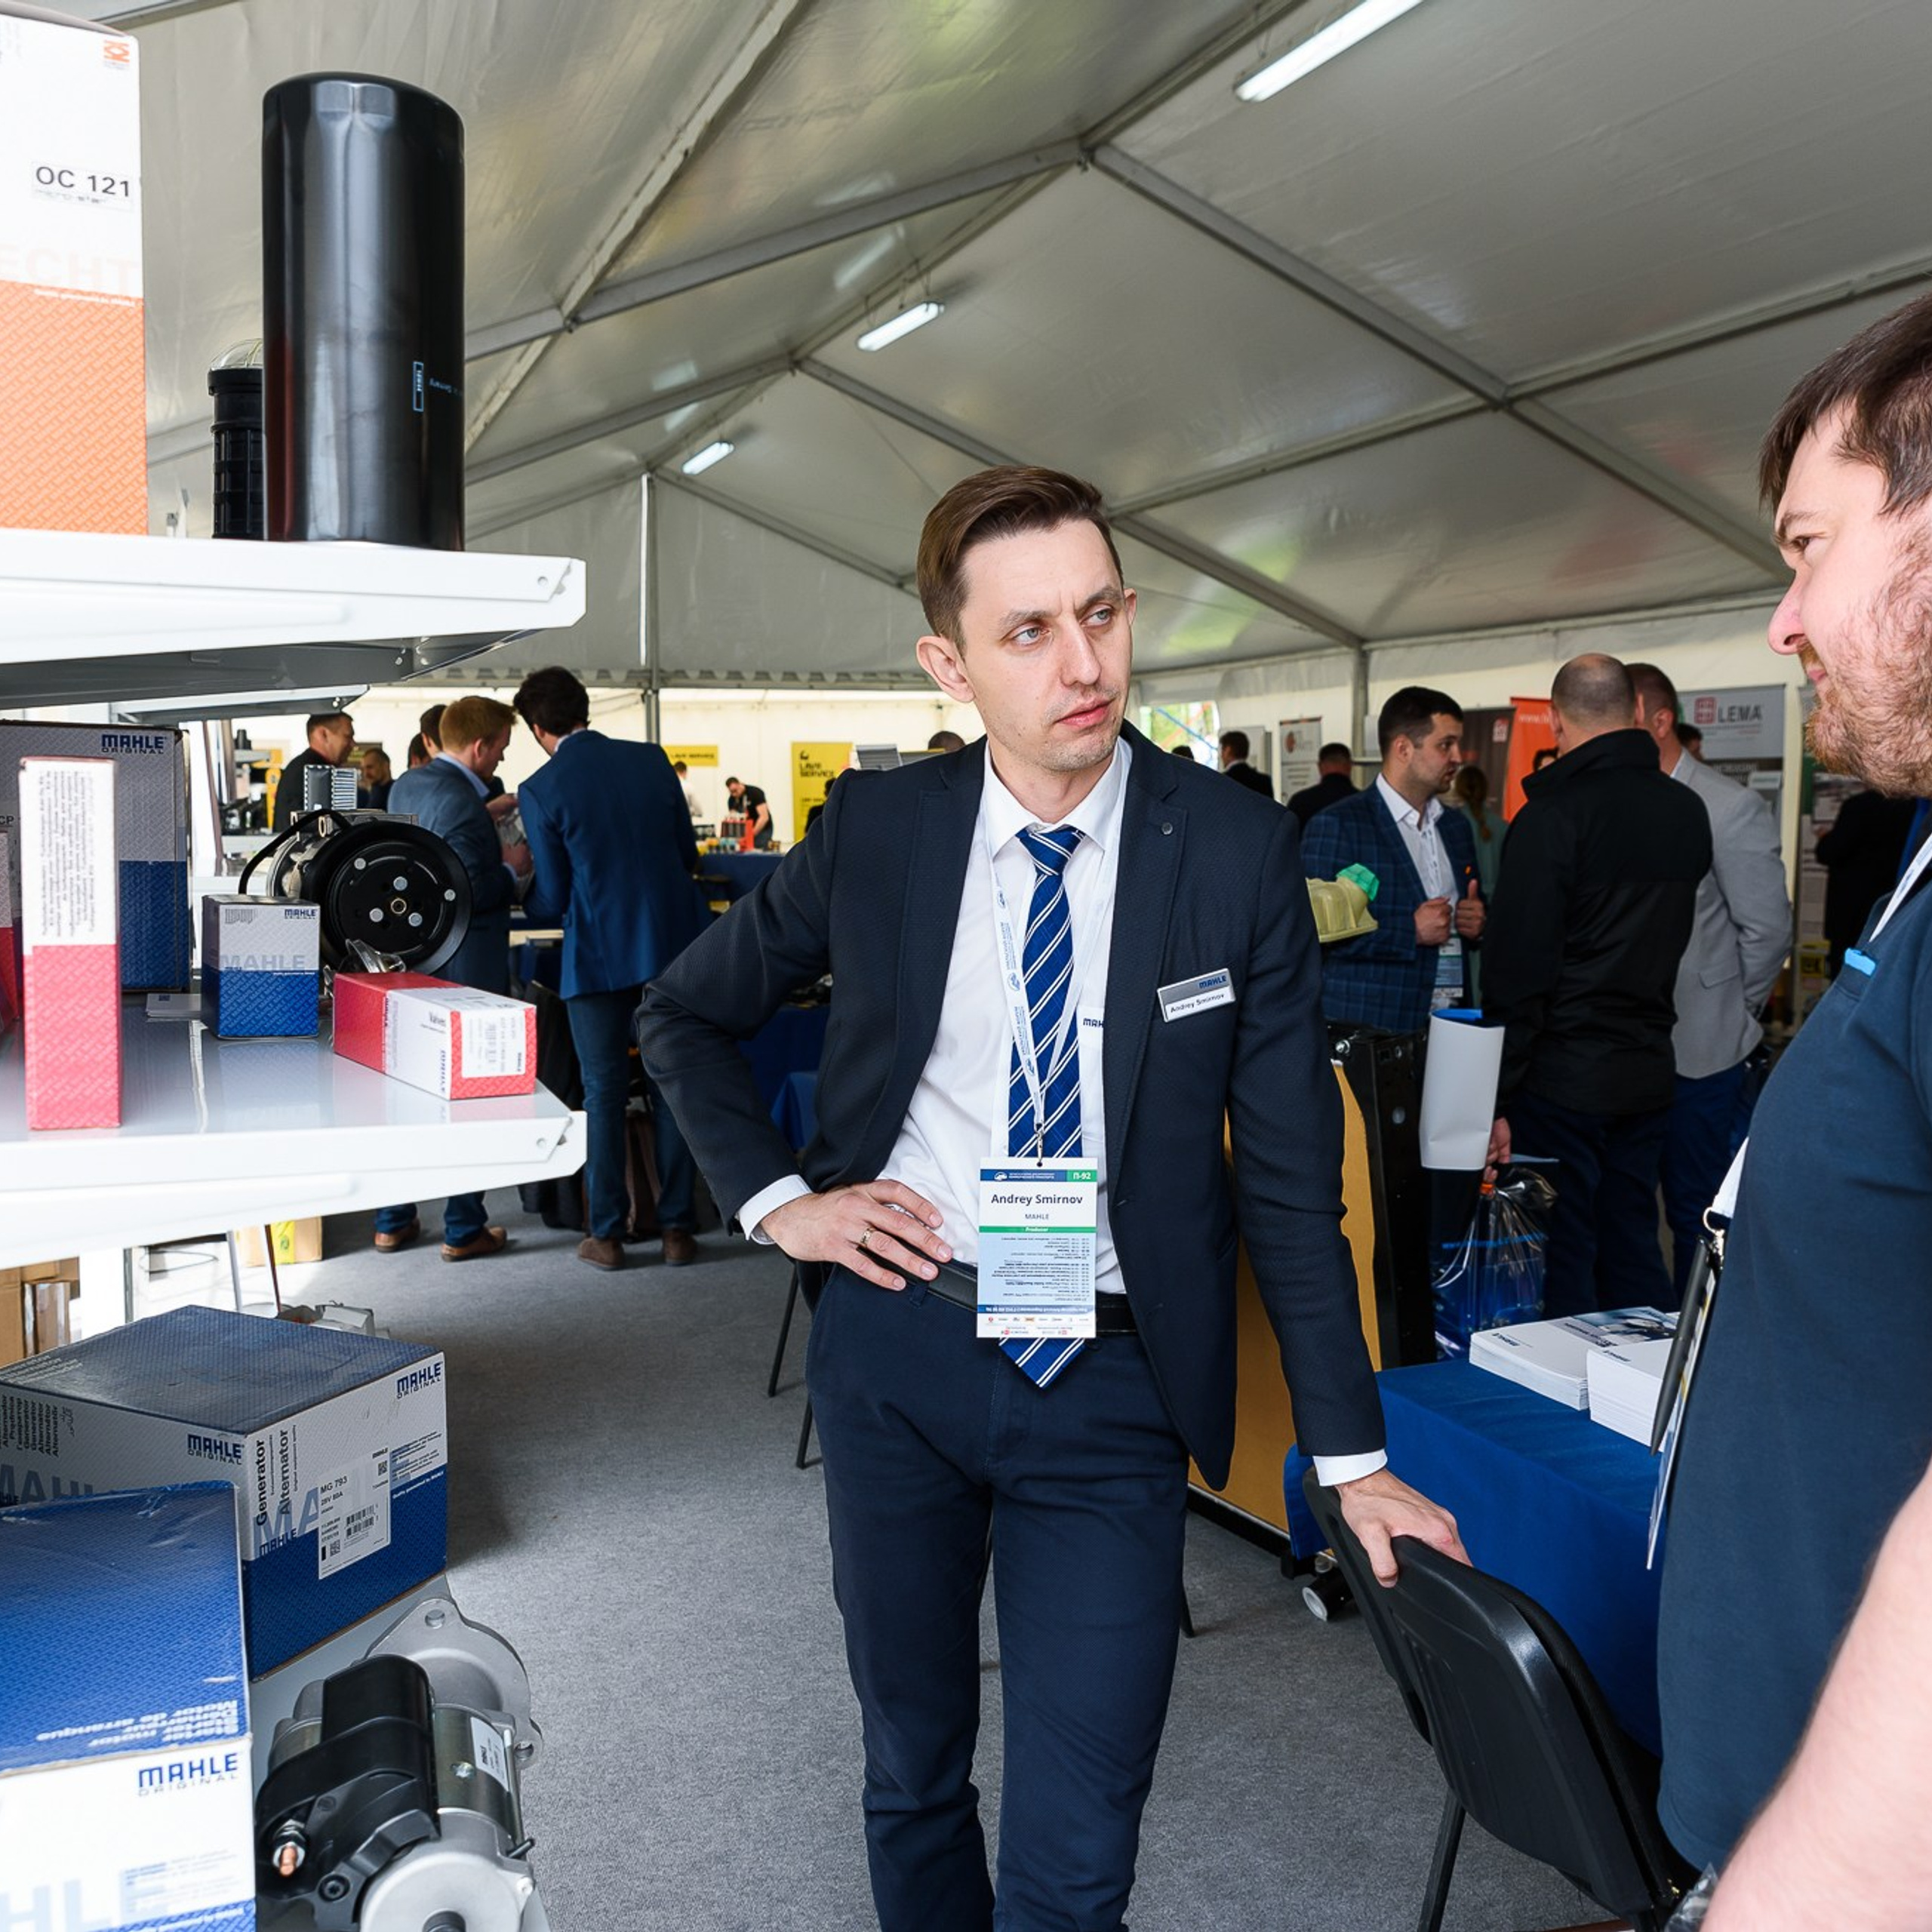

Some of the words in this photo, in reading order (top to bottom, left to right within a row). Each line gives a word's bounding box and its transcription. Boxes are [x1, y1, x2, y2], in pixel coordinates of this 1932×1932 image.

[35, 165, 76, 189] OC
[86, 174, 131, 198] 121
[1718, 706, 1762, 723] LEMA
[101, 734, 167, 749] MAHLE
[285, 909, 317, 917] MAHLE
[1198, 975, 1227, 989] MAHLE
[1171, 1002, 1195, 1014] Andrey
[1195, 994, 1224, 1006] Smirnov
[1083, 1017, 1104, 1029] MAH
[1072, 1172, 1091, 1180] П-92
[991, 1194, 1032, 1207] Andrey
[1035, 1194, 1083, 1204] Smirnov
[397, 1361, 443, 1394] MAHLE
[396, 1377, 441, 1400] ORIGINAL
[186, 1433, 245, 1460] MAHLE
[187, 1448, 242, 1466] ORIGINAL
[278, 1429, 291, 1515] Alternator
[255, 1439, 268, 1527] Generator
[320, 1482, 334, 1494] MG
[334, 1475, 348, 1489] 793
[259, 1527, 297, 1557] MAHLE
[137, 1752, 238, 1789] MAHLE
[137, 1774, 238, 1798] ORIGINAL
